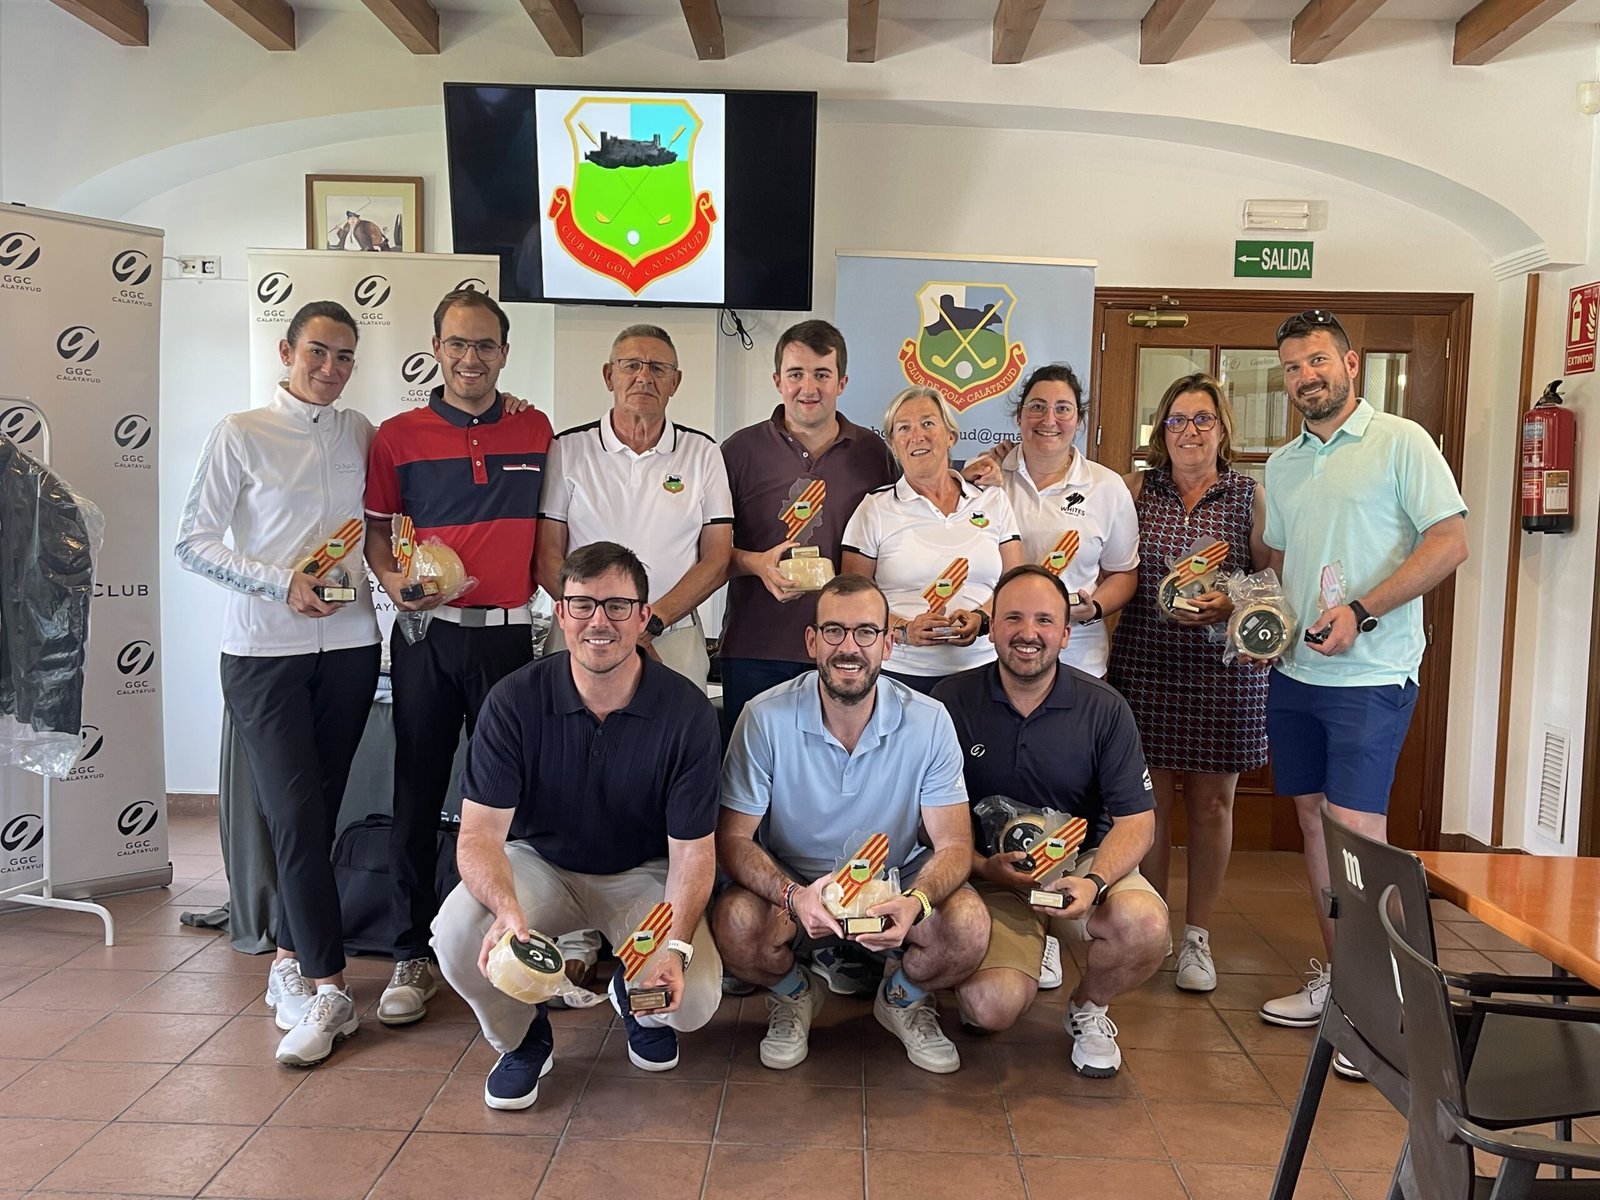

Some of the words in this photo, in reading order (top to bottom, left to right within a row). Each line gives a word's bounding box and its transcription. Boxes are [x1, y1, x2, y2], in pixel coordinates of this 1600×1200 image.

[561, 225, 584, 251] CLUB
[588, 249, 602, 265] DE
[606, 261, 633, 281] GOLF
[644, 230, 704, 277] CALATAYUD
[1261, 247, 1310, 271] SALIDA
[3, 274, 32, 285] GGC
[0, 283, 42, 293] ALATAYUD
[120, 290, 144, 300] GGC
[112, 297, 152, 307] CALATAYUD
[263, 310, 285, 318] GGC
[1568, 353, 1593, 366] EXTINTOR
[65, 367, 92, 376] GGC
[56, 374, 100, 383] CALATAYUD
[906, 361, 925, 385] CLUB
[940, 387, 965, 405] GOLF
[966, 367, 1017, 403] CALATAYUD
[408, 389, 431, 397] GGC
[121, 454, 144, 462] GGC
[1060, 506, 1085, 516] WHITES
[93, 583, 149, 597] CLUB
[125, 680, 149, 689] GGC
[69, 765, 95, 775] GGC
[125, 839, 150, 849] GGC
[117, 846, 159, 857] CALATAYUD
[10, 855, 37, 866] GGC
[0, 863, 44, 873] CALATAYU
